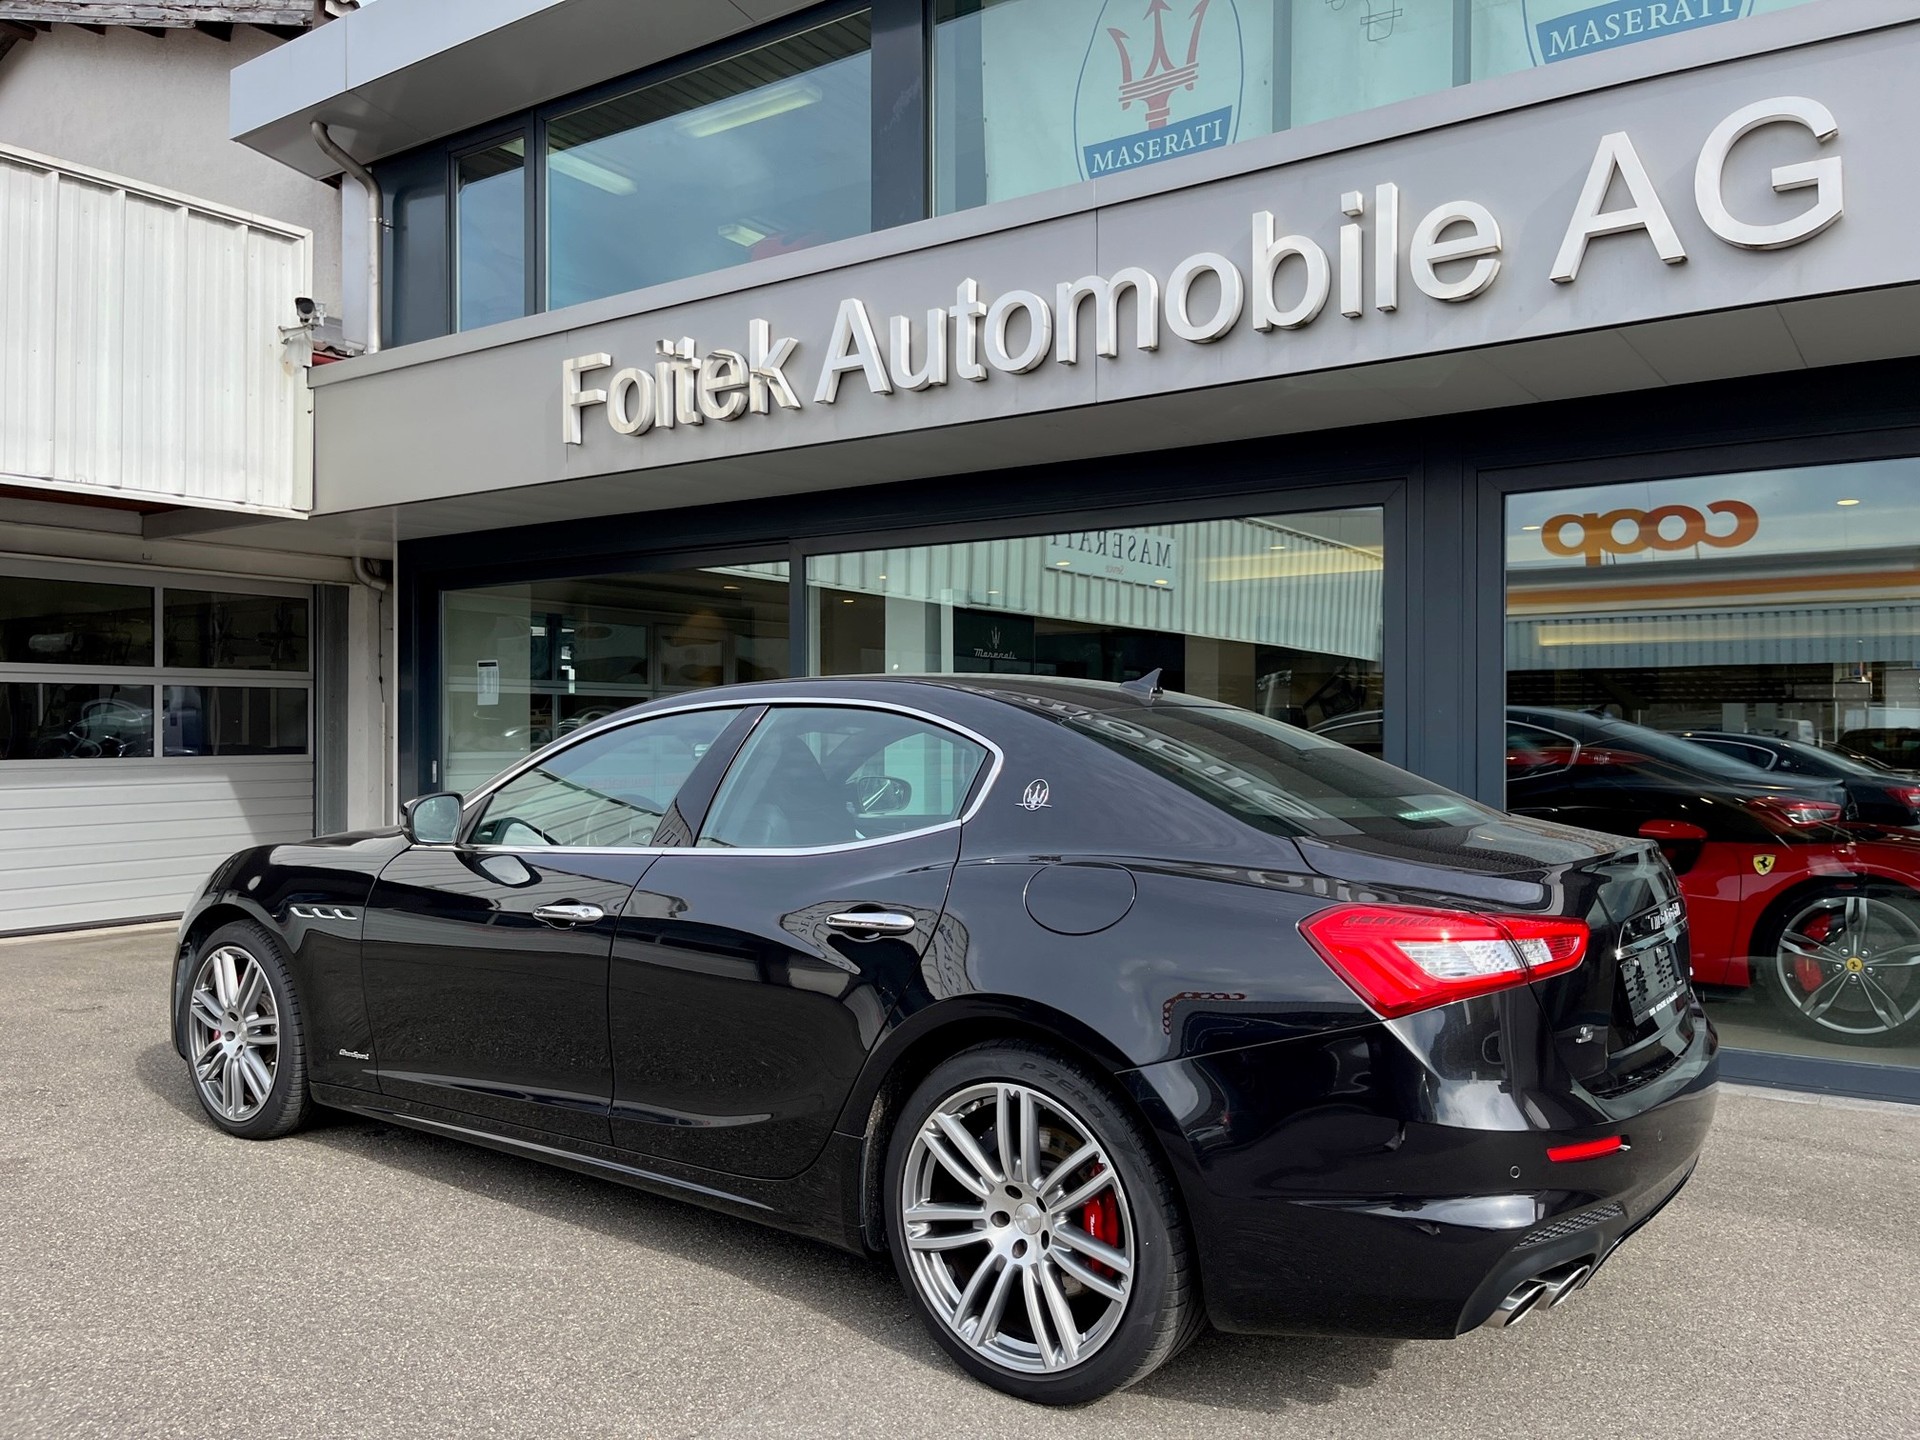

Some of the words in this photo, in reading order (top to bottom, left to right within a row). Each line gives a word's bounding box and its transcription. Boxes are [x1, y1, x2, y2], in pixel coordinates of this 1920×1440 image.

[1091, 119, 1223, 174] MASERATI
[562, 318, 801, 445] Foitek
[812, 181, 1503, 405] Automobile
[1549, 96, 1844, 284] AG
[1039, 1069, 1105, 1118] ZERO
